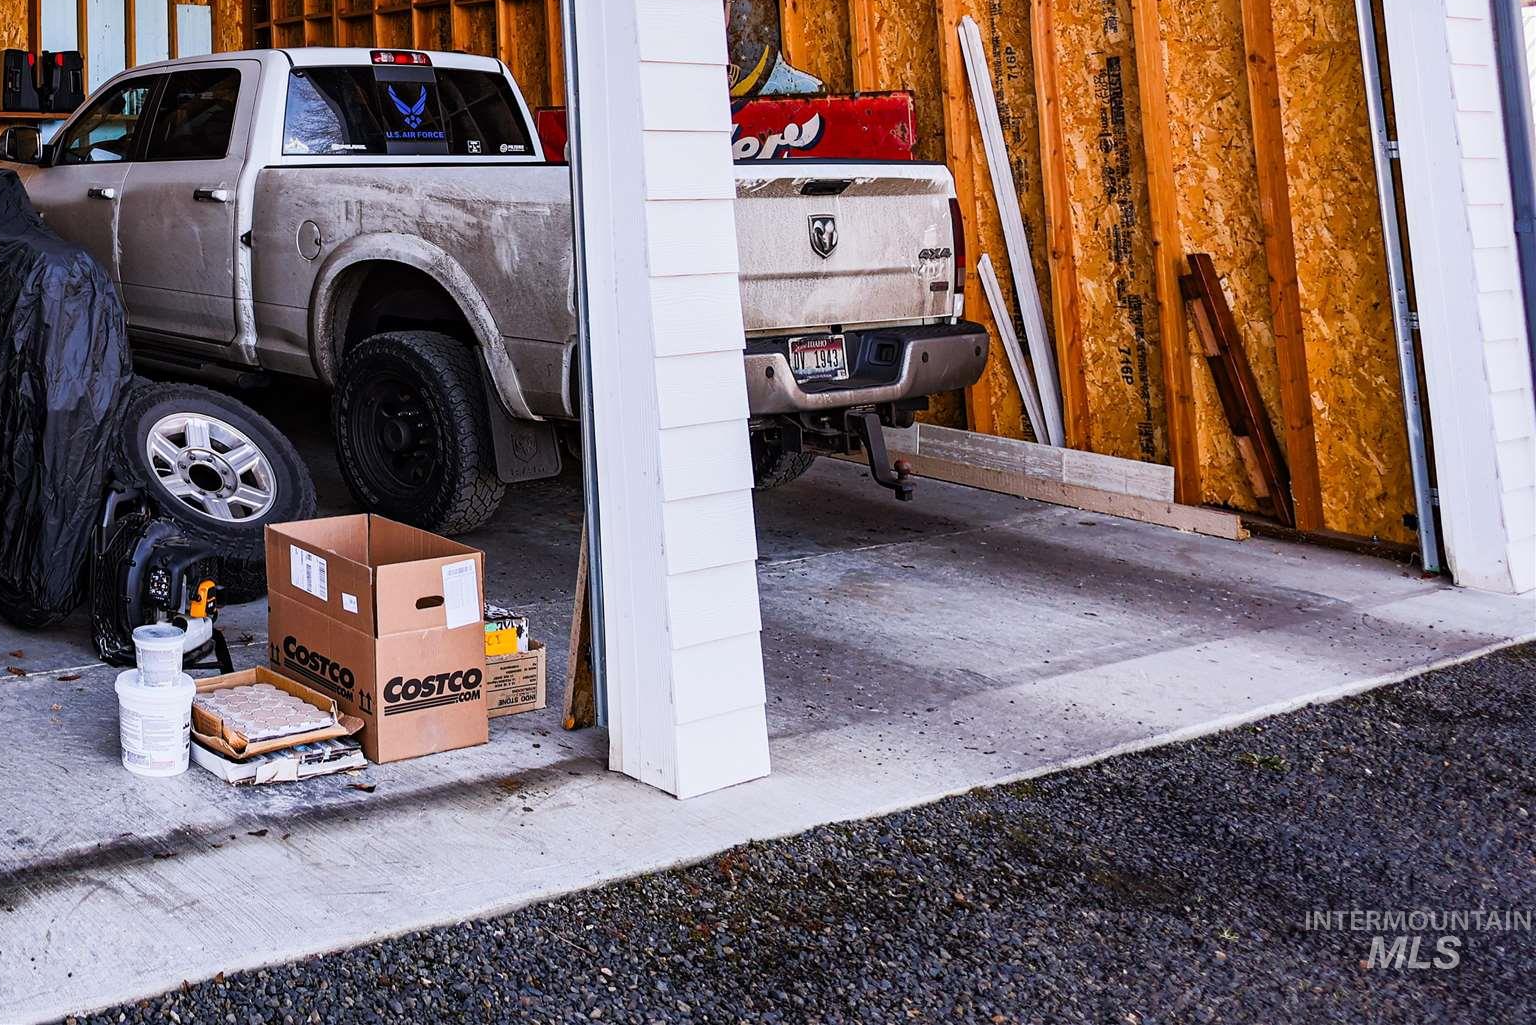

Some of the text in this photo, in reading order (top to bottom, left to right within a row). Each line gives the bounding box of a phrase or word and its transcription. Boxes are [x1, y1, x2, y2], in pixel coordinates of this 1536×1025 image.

[402, 131, 416, 139] AIR
[417, 131, 445, 139] FORCE
[815, 349, 839, 369] 1943
[283, 635, 355, 689] COSTCO
[383, 667, 483, 704] COSTCO
[498, 697, 519, 706] STONE
